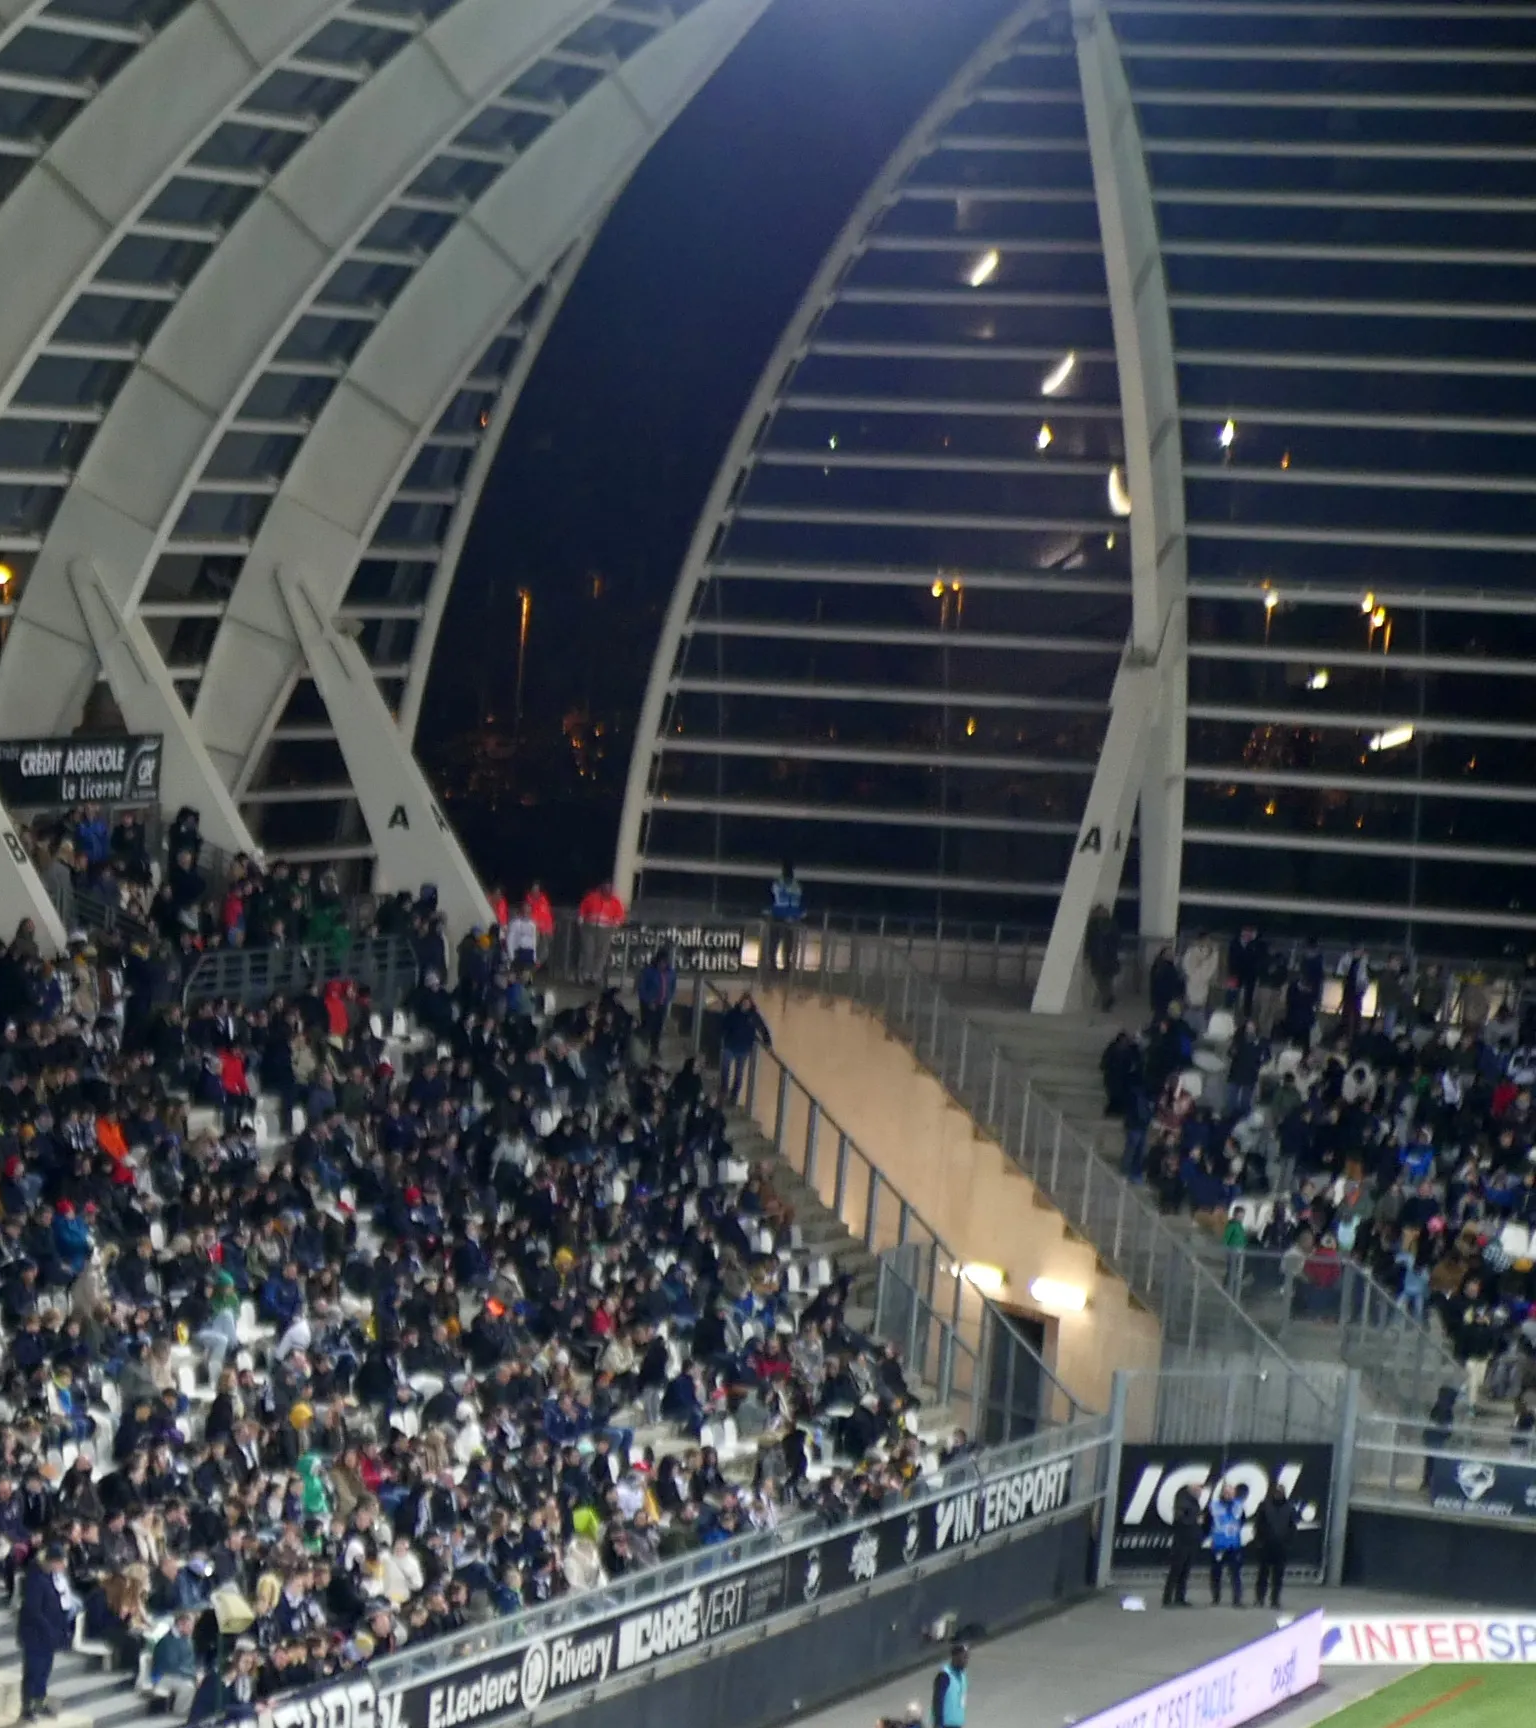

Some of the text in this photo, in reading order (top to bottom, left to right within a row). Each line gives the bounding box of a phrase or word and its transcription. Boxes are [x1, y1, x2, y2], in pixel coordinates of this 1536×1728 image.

[20, 744, 63, 777] CRÉDIT
[64, 745, 126, 774] AGRICOLE
[62, 778, 76, 800] La
[79, 777, 122, 799] Licorne
[388, 804, 410, 831] A
[3, 831, 27, 864] B
[1079, 825, 1102, 854] A
[550, 1634, 615, 1689] Rivery
[1195, 1669, 1238, 1728] FACILE
